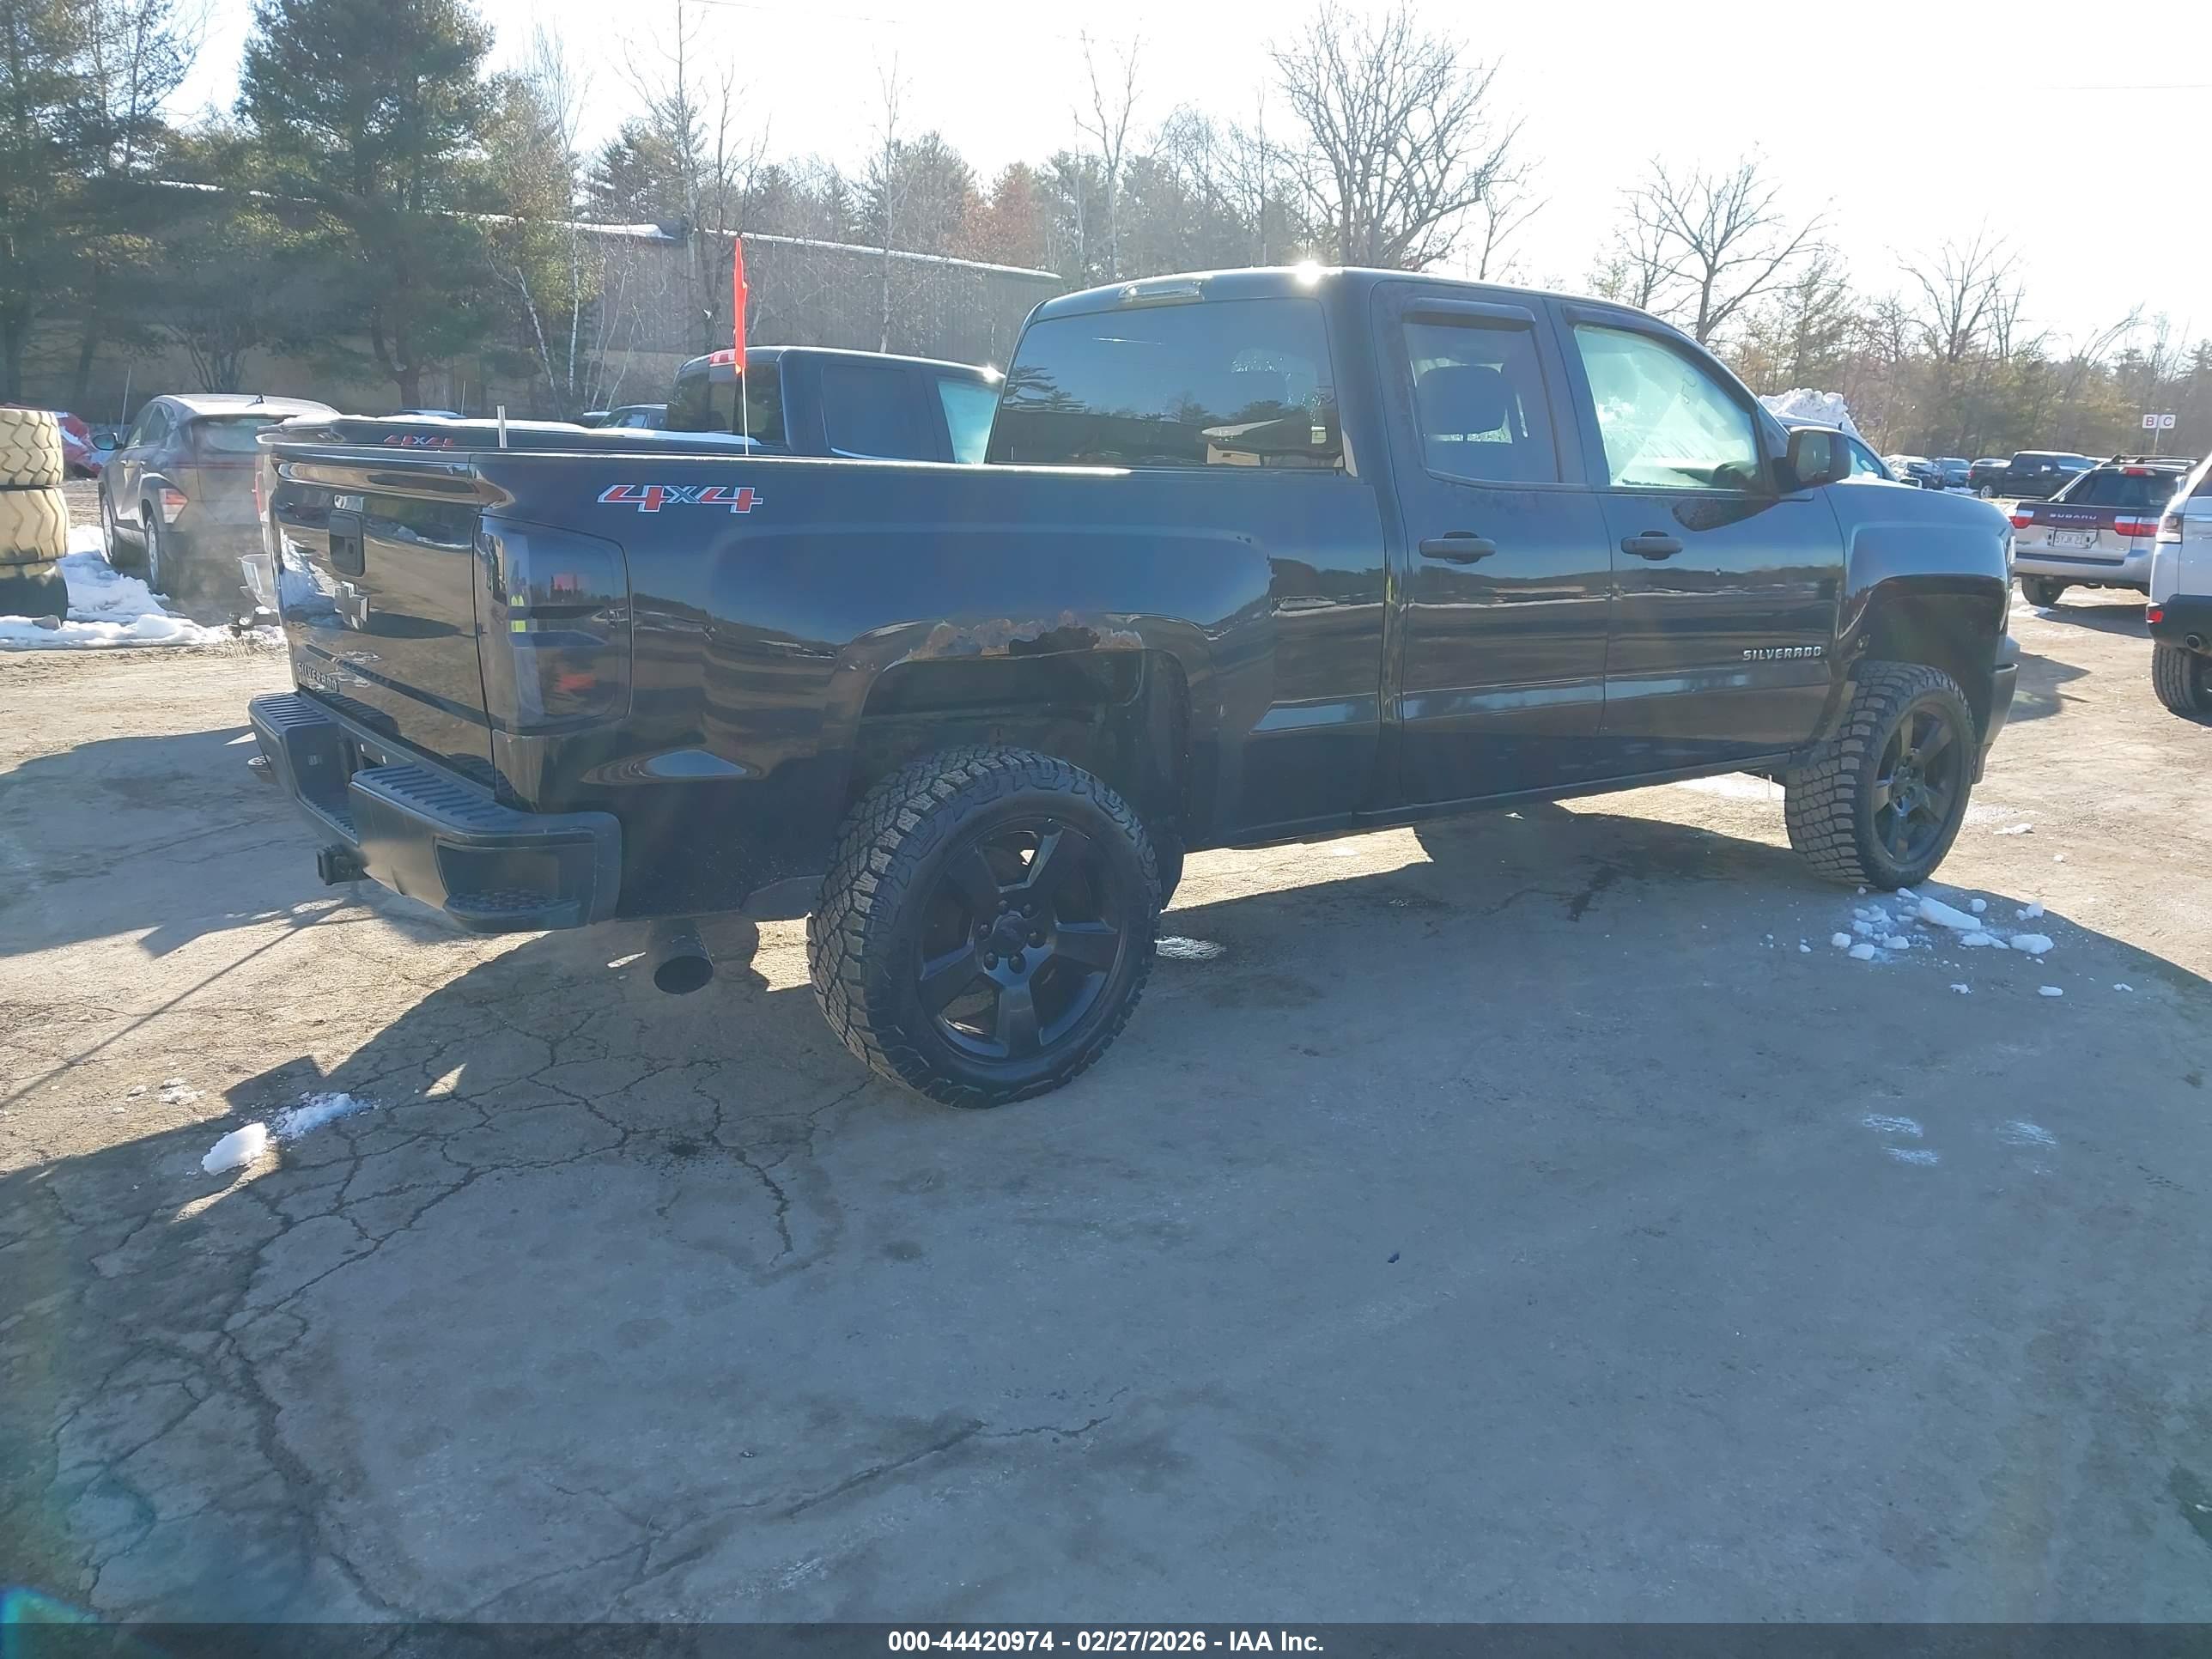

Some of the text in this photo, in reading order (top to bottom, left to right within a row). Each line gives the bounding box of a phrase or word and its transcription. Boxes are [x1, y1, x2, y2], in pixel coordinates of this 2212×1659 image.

[2146, 416, 2154, 427] B
[2163, 416, 2172, 427] C
[1742, 646, 1822, 661] SILVERADO
